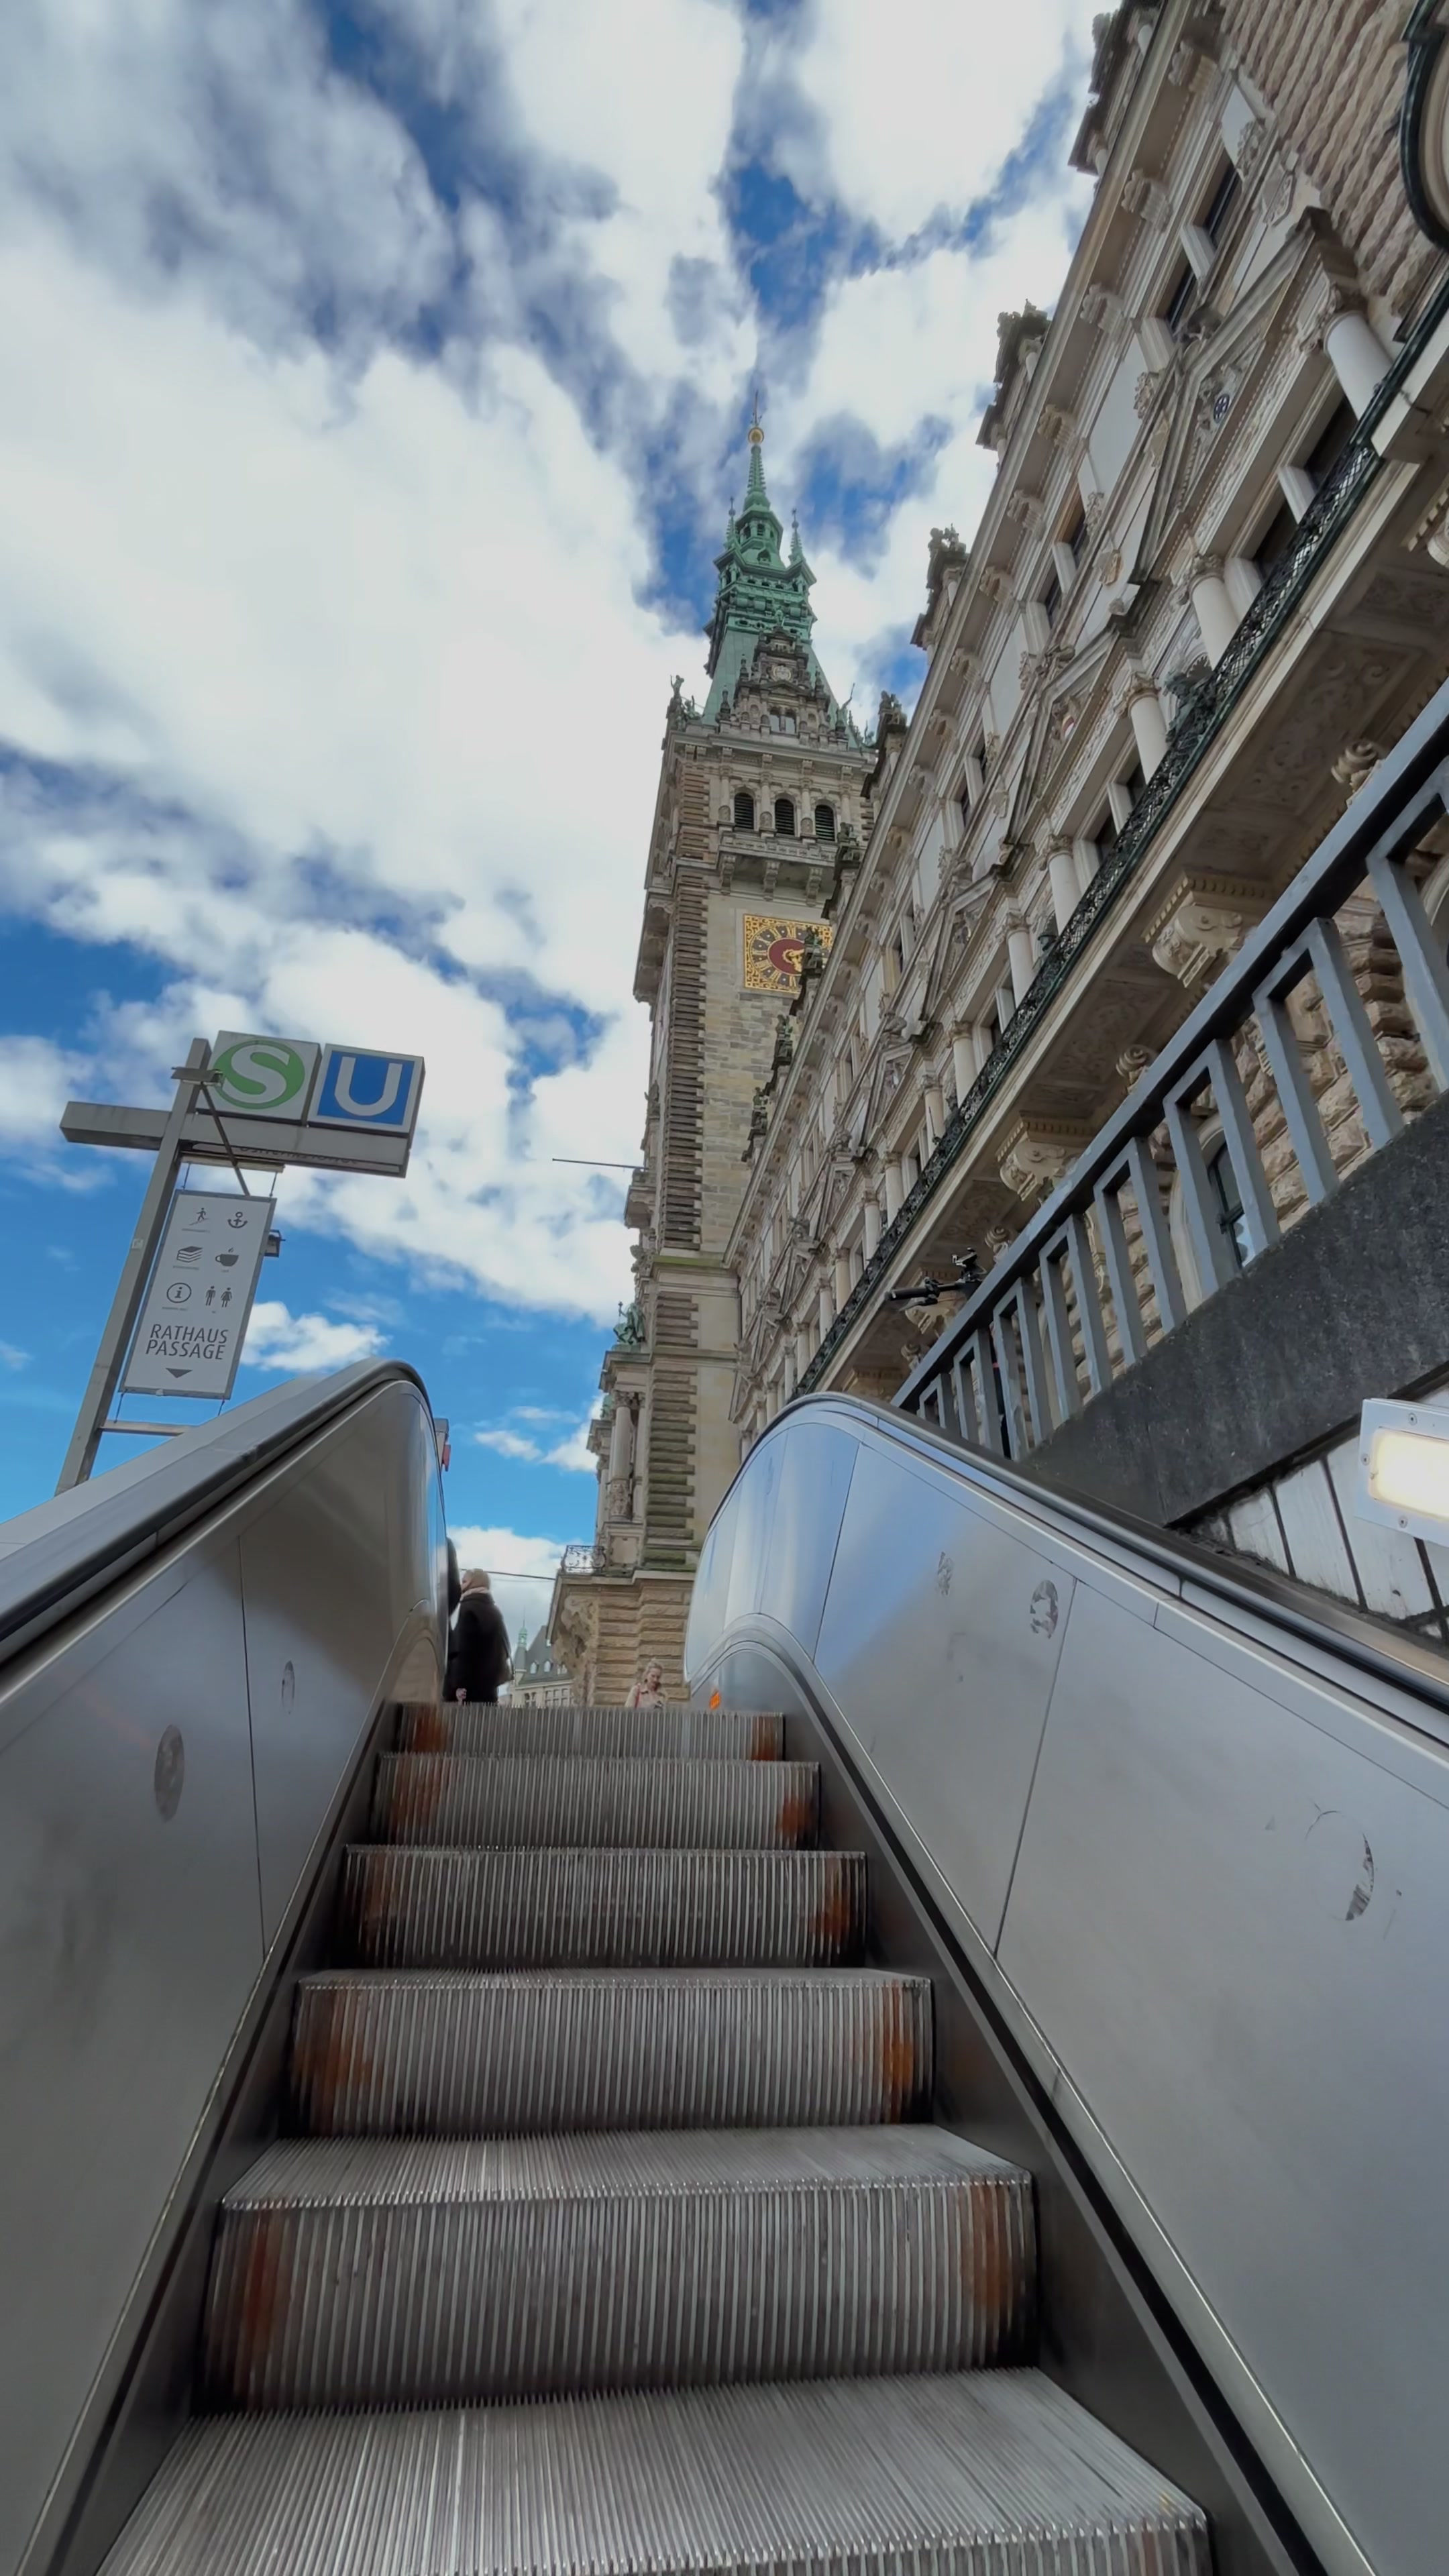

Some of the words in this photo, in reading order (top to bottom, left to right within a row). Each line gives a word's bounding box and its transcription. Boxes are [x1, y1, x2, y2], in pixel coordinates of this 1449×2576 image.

[222, 1044, 290, 1104] S
[334, 1057, 403, 1116] U
[150, 1324, 229, 1344] RATHAUS
[146, 1339, 225, 1360] PASSAGE
